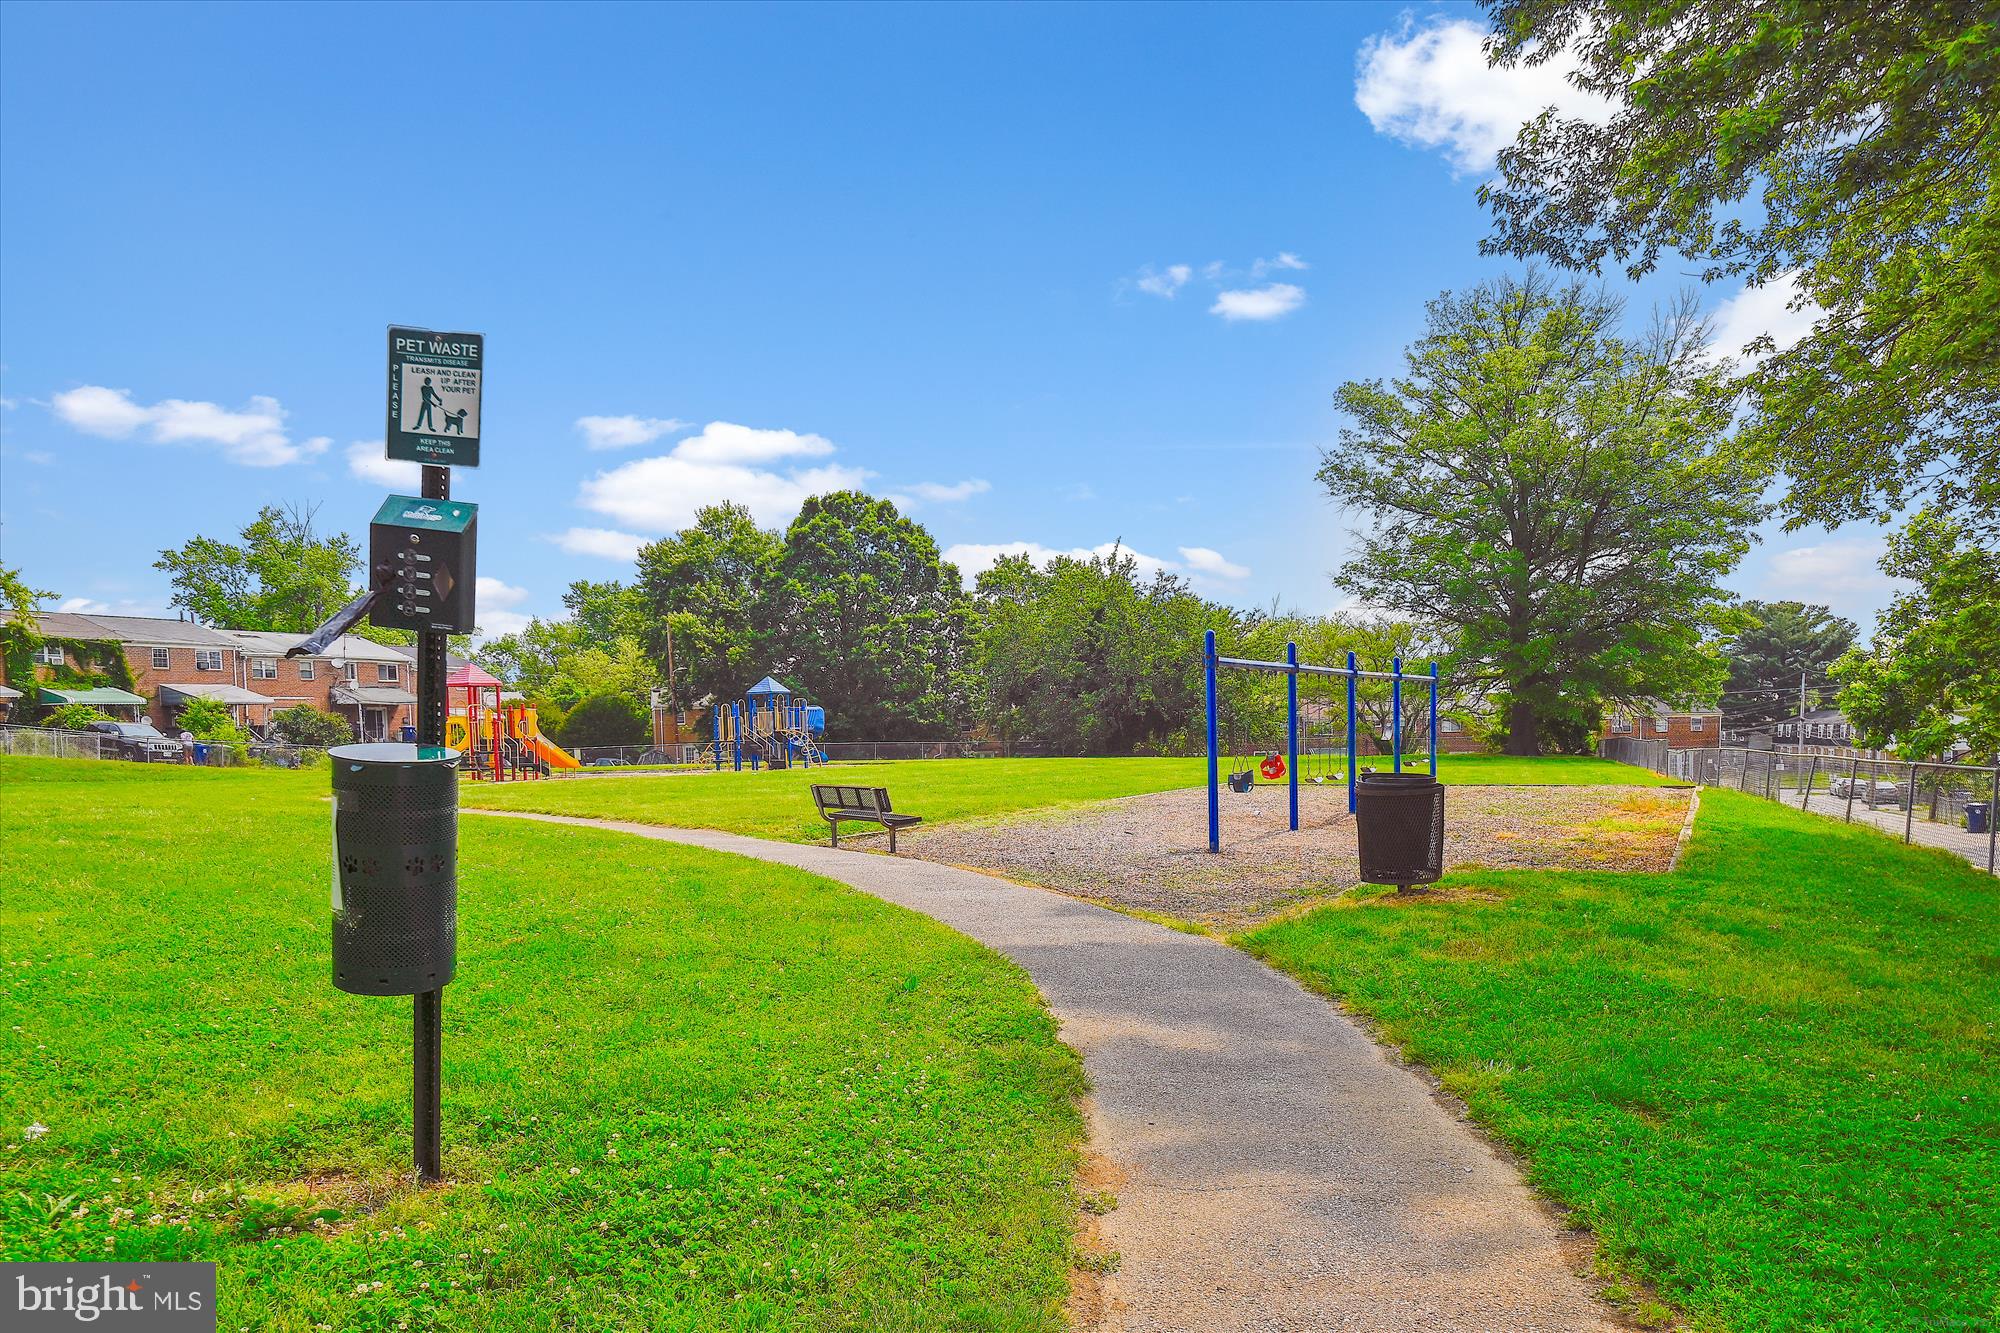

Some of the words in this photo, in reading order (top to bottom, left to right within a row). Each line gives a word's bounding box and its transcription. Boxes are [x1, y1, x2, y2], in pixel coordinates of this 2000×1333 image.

[396, 338, 425, 352] PET
[429, 341, 478, 357] WASTE
[406, 355, 442, 364] TRANSMITS
[442, 358, 469, 367] DISEASE
[411, 366, 435, 375] LEASH
[436, 368, 452, 377] AND
[452, 370, 477, 379] CLEAN
[440, 377, 450, 385] UP
[453, 378, 476, 387] AFTER
[441, 385, 461, 394] YOUR
[462, 387, 476, 395] PET
[420, 438, 436, 446] KEEP
[437, 439, 451, 447] THIS
[416, 445, 434, 453] AREA
[434, 446, 455, 455] CLEAN
